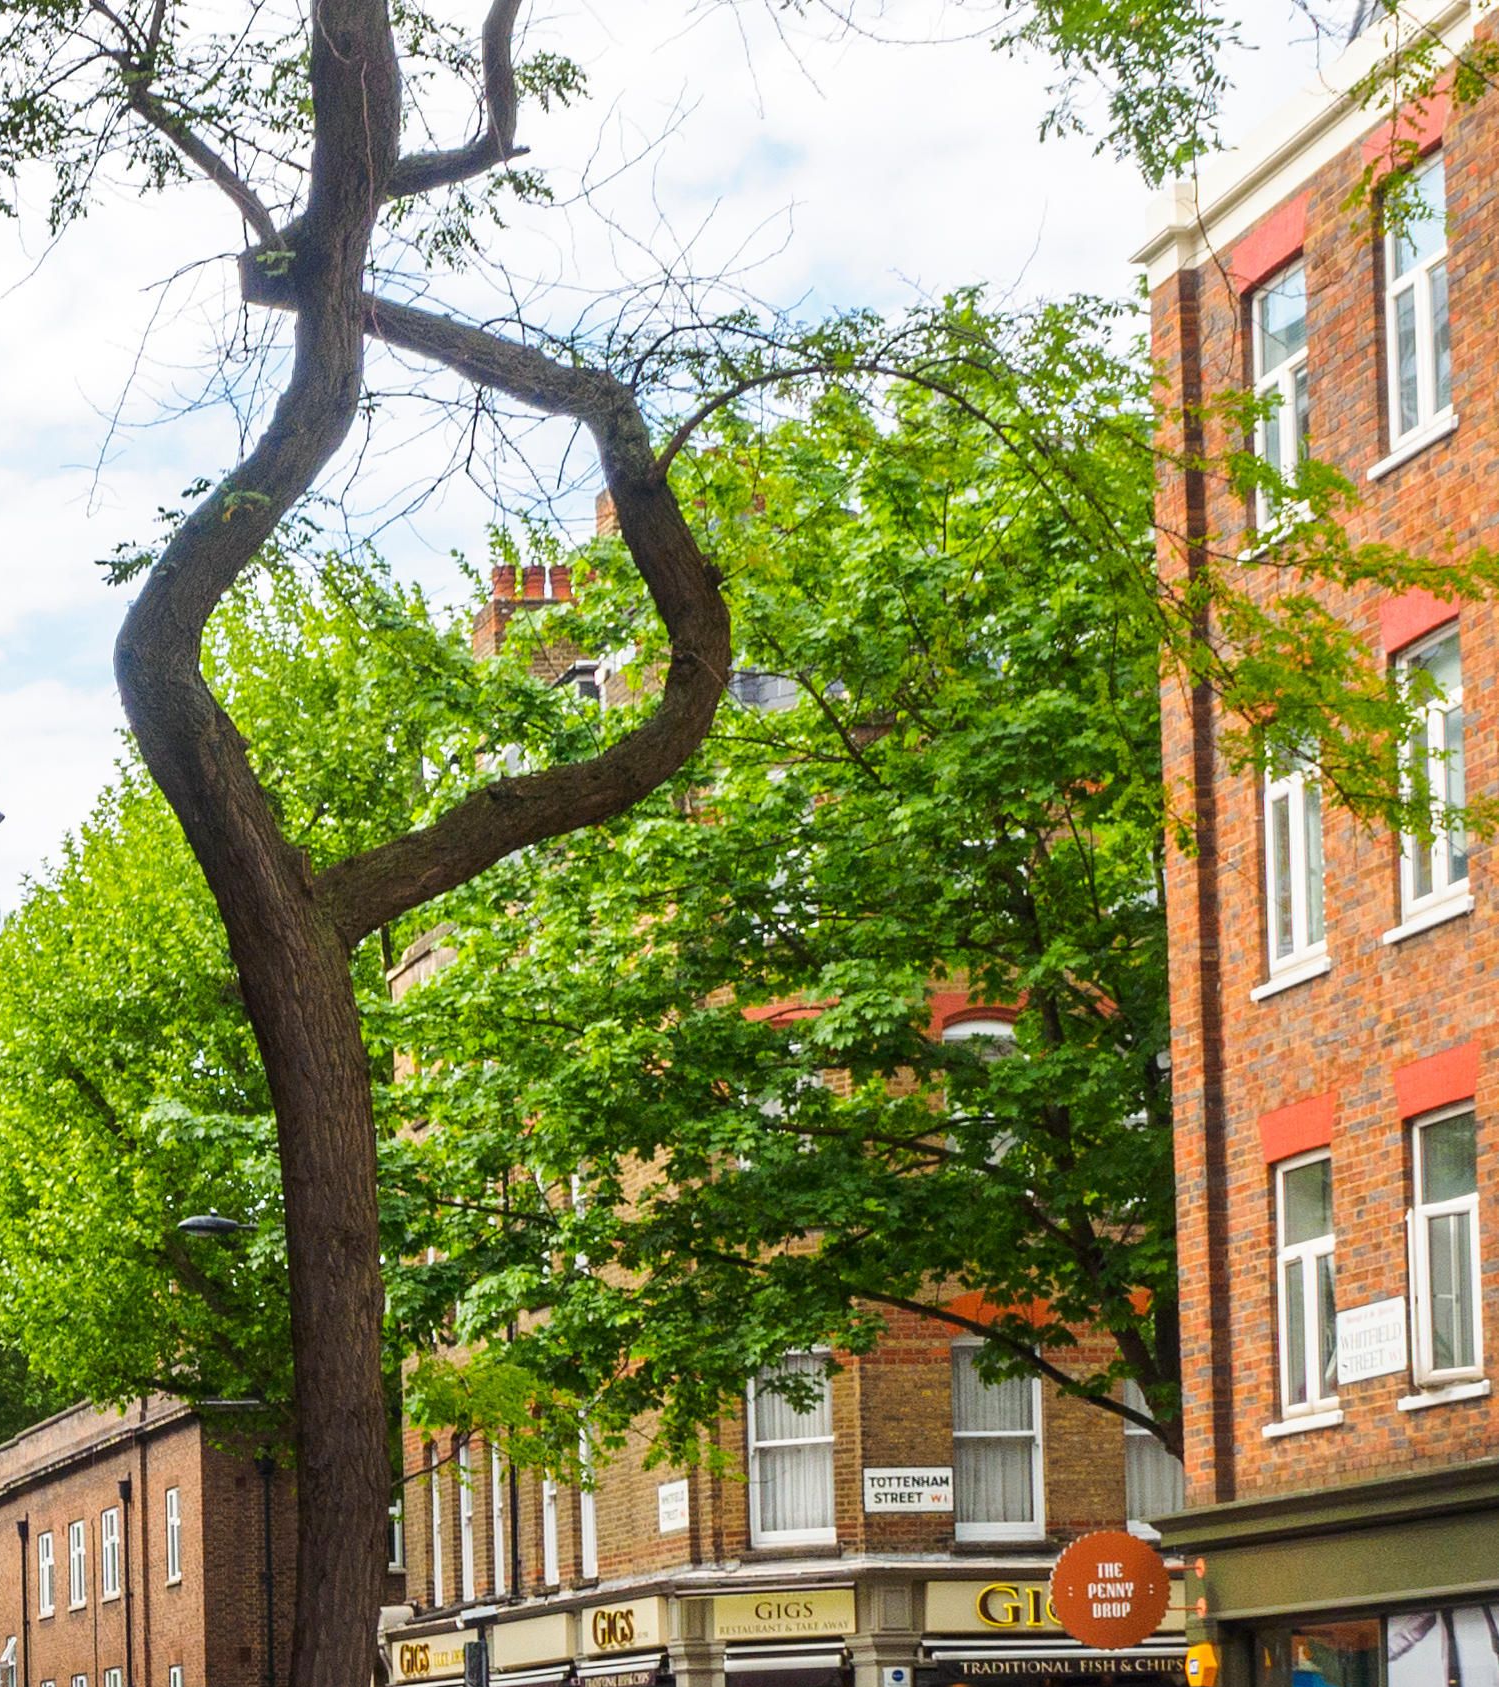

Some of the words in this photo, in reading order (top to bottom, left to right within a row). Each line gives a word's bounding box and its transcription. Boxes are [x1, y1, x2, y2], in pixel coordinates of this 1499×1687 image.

[868, 1476, 950, 1488] TOTTENHAM
[874, 1491, 923, 1504] STREET
[1097, 1562, 1123, 1578] THE
[1088, 1582, 1134, 1598] PENNY
[754, 1600, 814, 1620] GIGS
[1092, 1602, 1131, 1618] DROP
[592, 1609, 634, 1650] GIGS
[719, 1623, 782, 1635] RESTAURANT
[785, 1623, 793, 1632] &
[796, 1622, 819, 1632] TAKE
[821, 1620, 849, 1631] AWAY
[400, 1644, 431, 1677] GIGS
[960, 1661, 1073, 1674] TRADITIONAL
[1079, 1660, 1116, 1672] FISH
[1120, 1660, 1133, 1671] &
[1135, 1659, 1184, 1672] CHIPS
